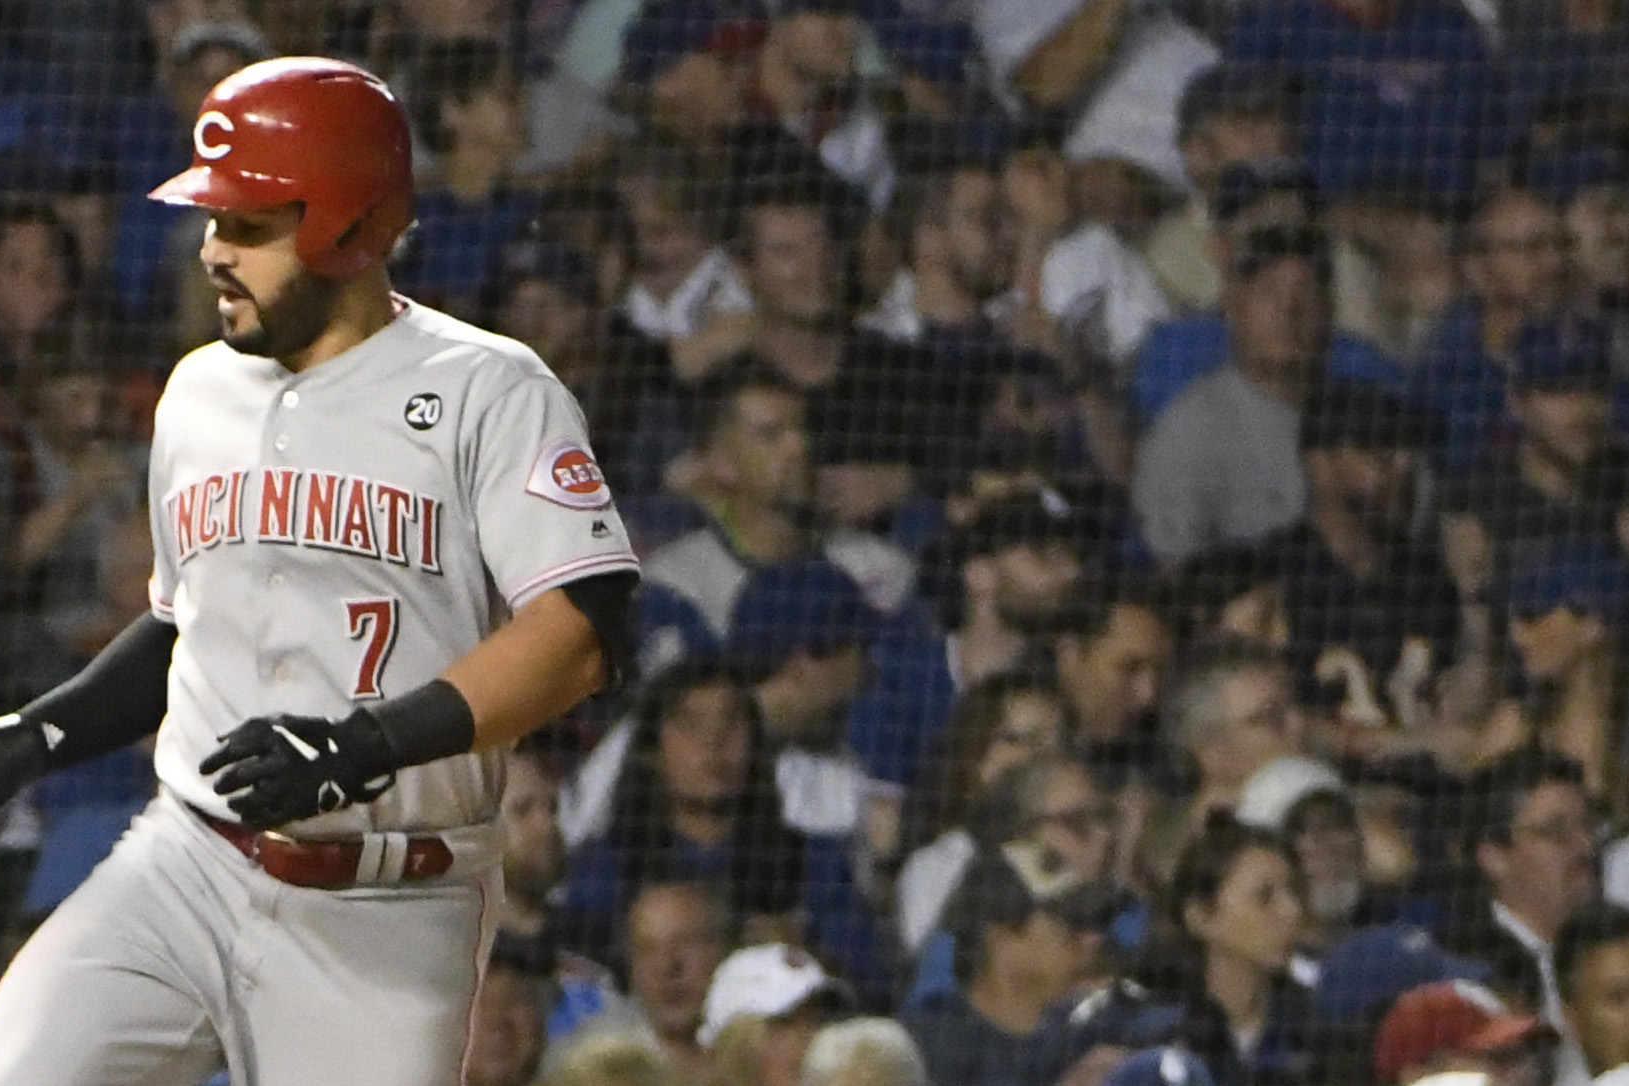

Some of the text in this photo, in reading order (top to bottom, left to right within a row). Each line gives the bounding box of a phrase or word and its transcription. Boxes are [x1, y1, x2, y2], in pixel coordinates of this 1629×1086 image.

[194, 110, 234, 160] C
[408, 397, 440, 425] 20
[342, 595, 400, 700] 7
